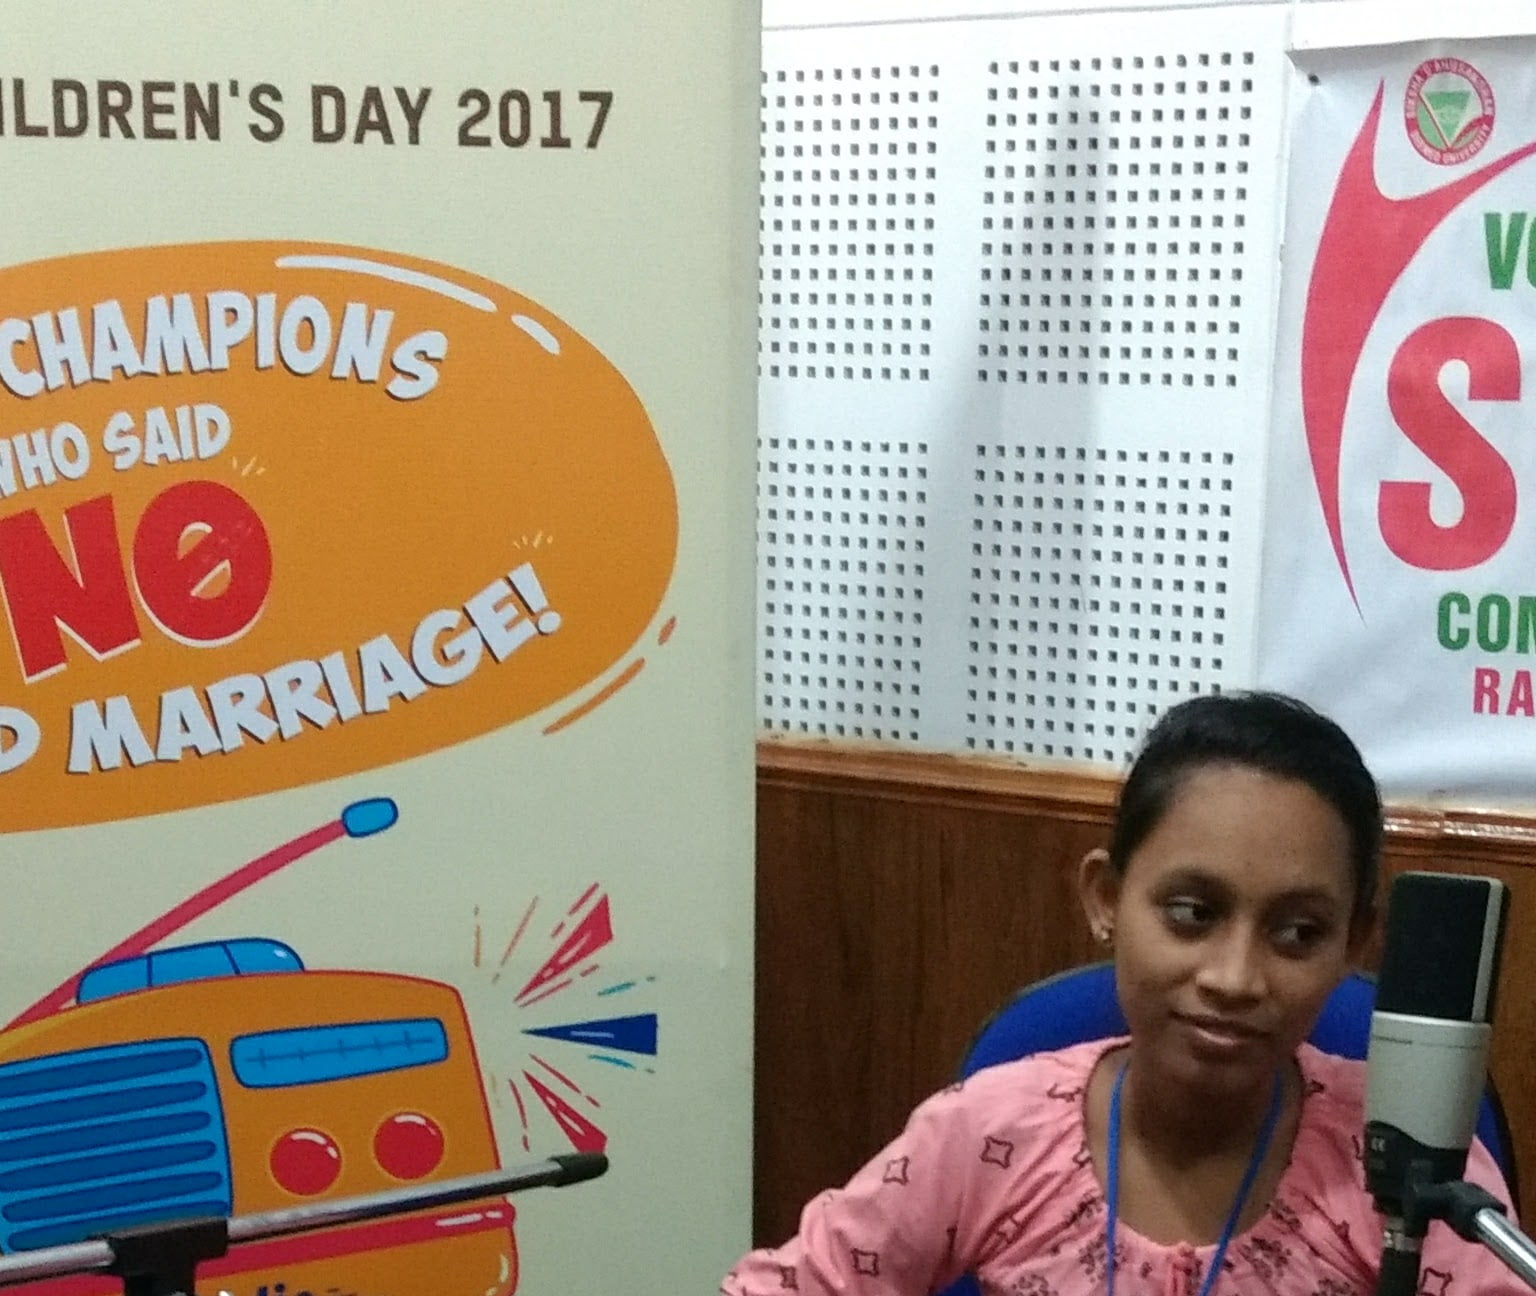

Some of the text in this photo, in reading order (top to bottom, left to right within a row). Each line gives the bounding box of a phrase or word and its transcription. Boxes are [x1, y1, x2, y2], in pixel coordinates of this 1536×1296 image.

[312, 86, 432, 146] DAY
[458, 89, 614, 149] 2017
[102, 404, 232, 472] SAID
[68, 564, 563, 774] MARRIAGE!
